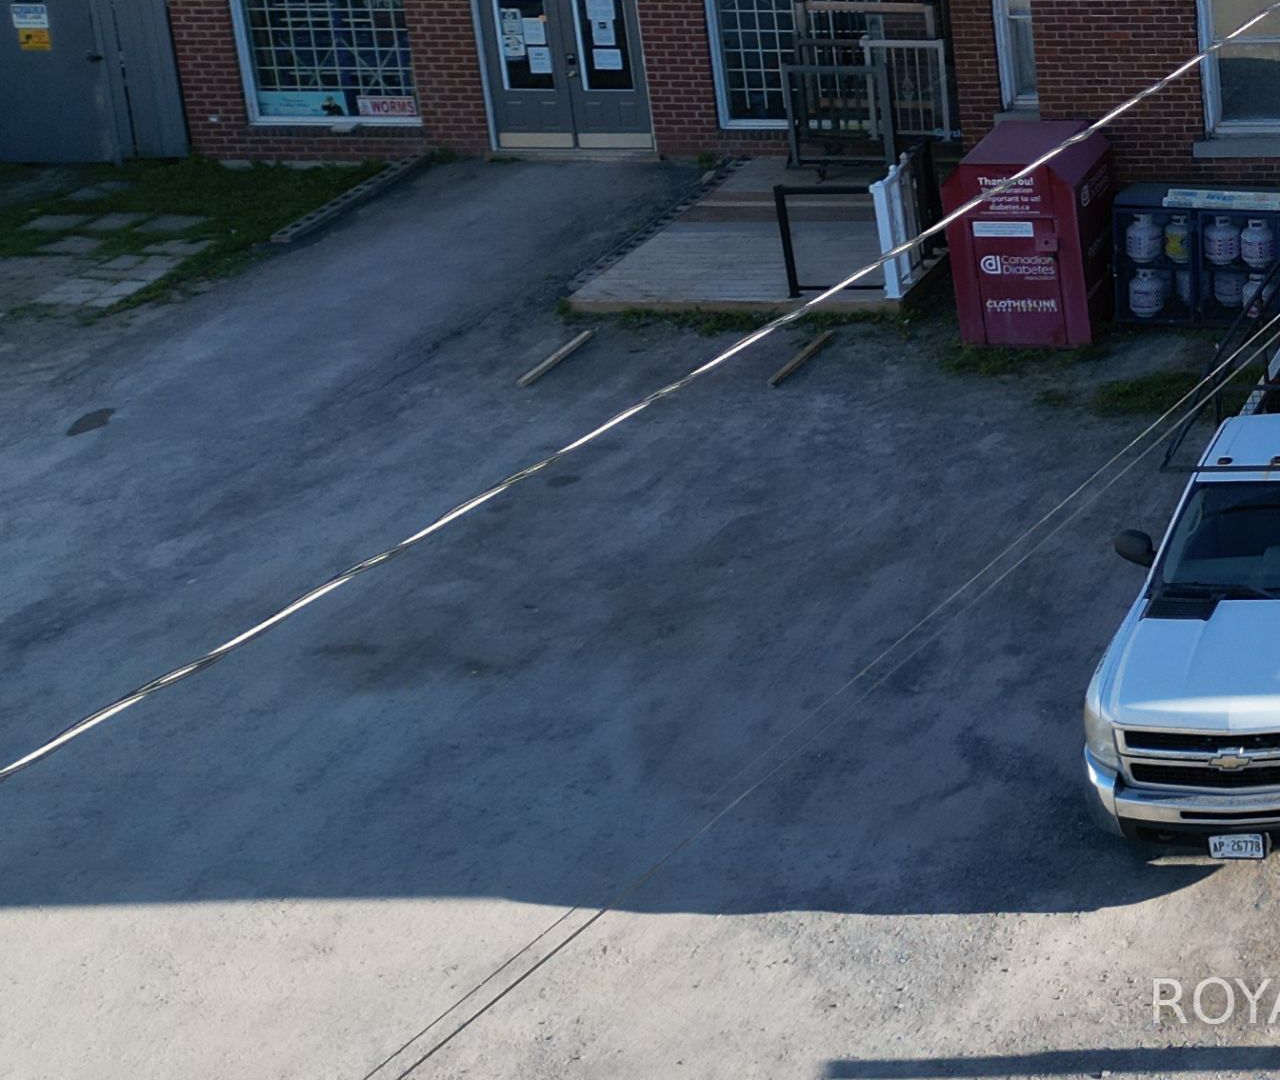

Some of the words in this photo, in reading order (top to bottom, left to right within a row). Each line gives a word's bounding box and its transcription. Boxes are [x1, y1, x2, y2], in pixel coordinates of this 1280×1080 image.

[371, 101, 415, 113] WORMS
[1002, 256, 1054, 264] Canadian
[1003, 265, 1056, 274] Diabetes
[986, 298, 1056, 308] CLOTHESLINE
[1213, 841, 1225, 852] AP
[1231, 840, 1260, 852] 26778
